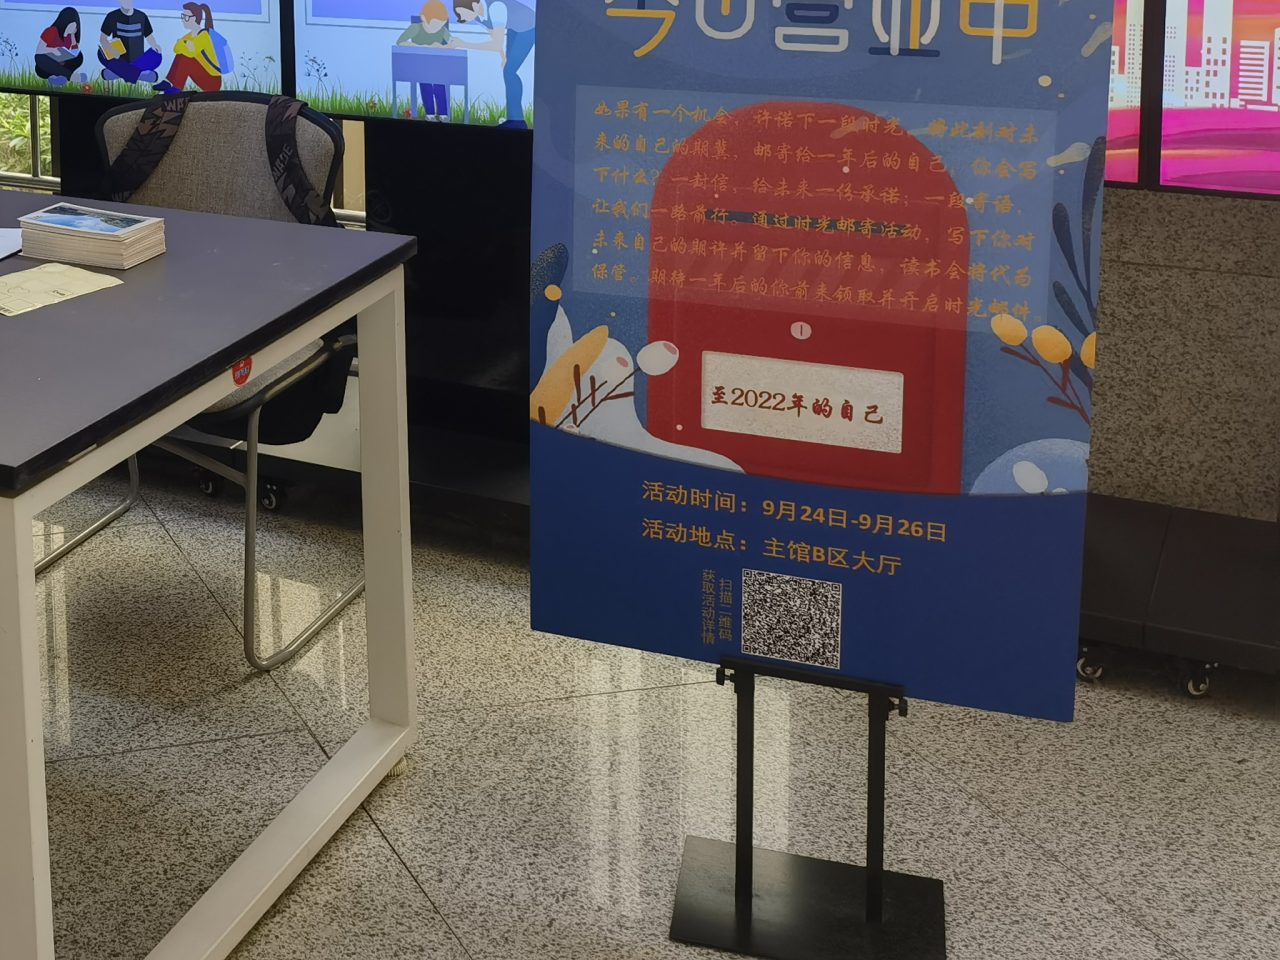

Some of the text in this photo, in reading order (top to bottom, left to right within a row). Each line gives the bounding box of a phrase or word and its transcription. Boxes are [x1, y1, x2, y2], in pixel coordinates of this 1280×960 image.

[710, 385, 884, 425] 至2022年的自己
